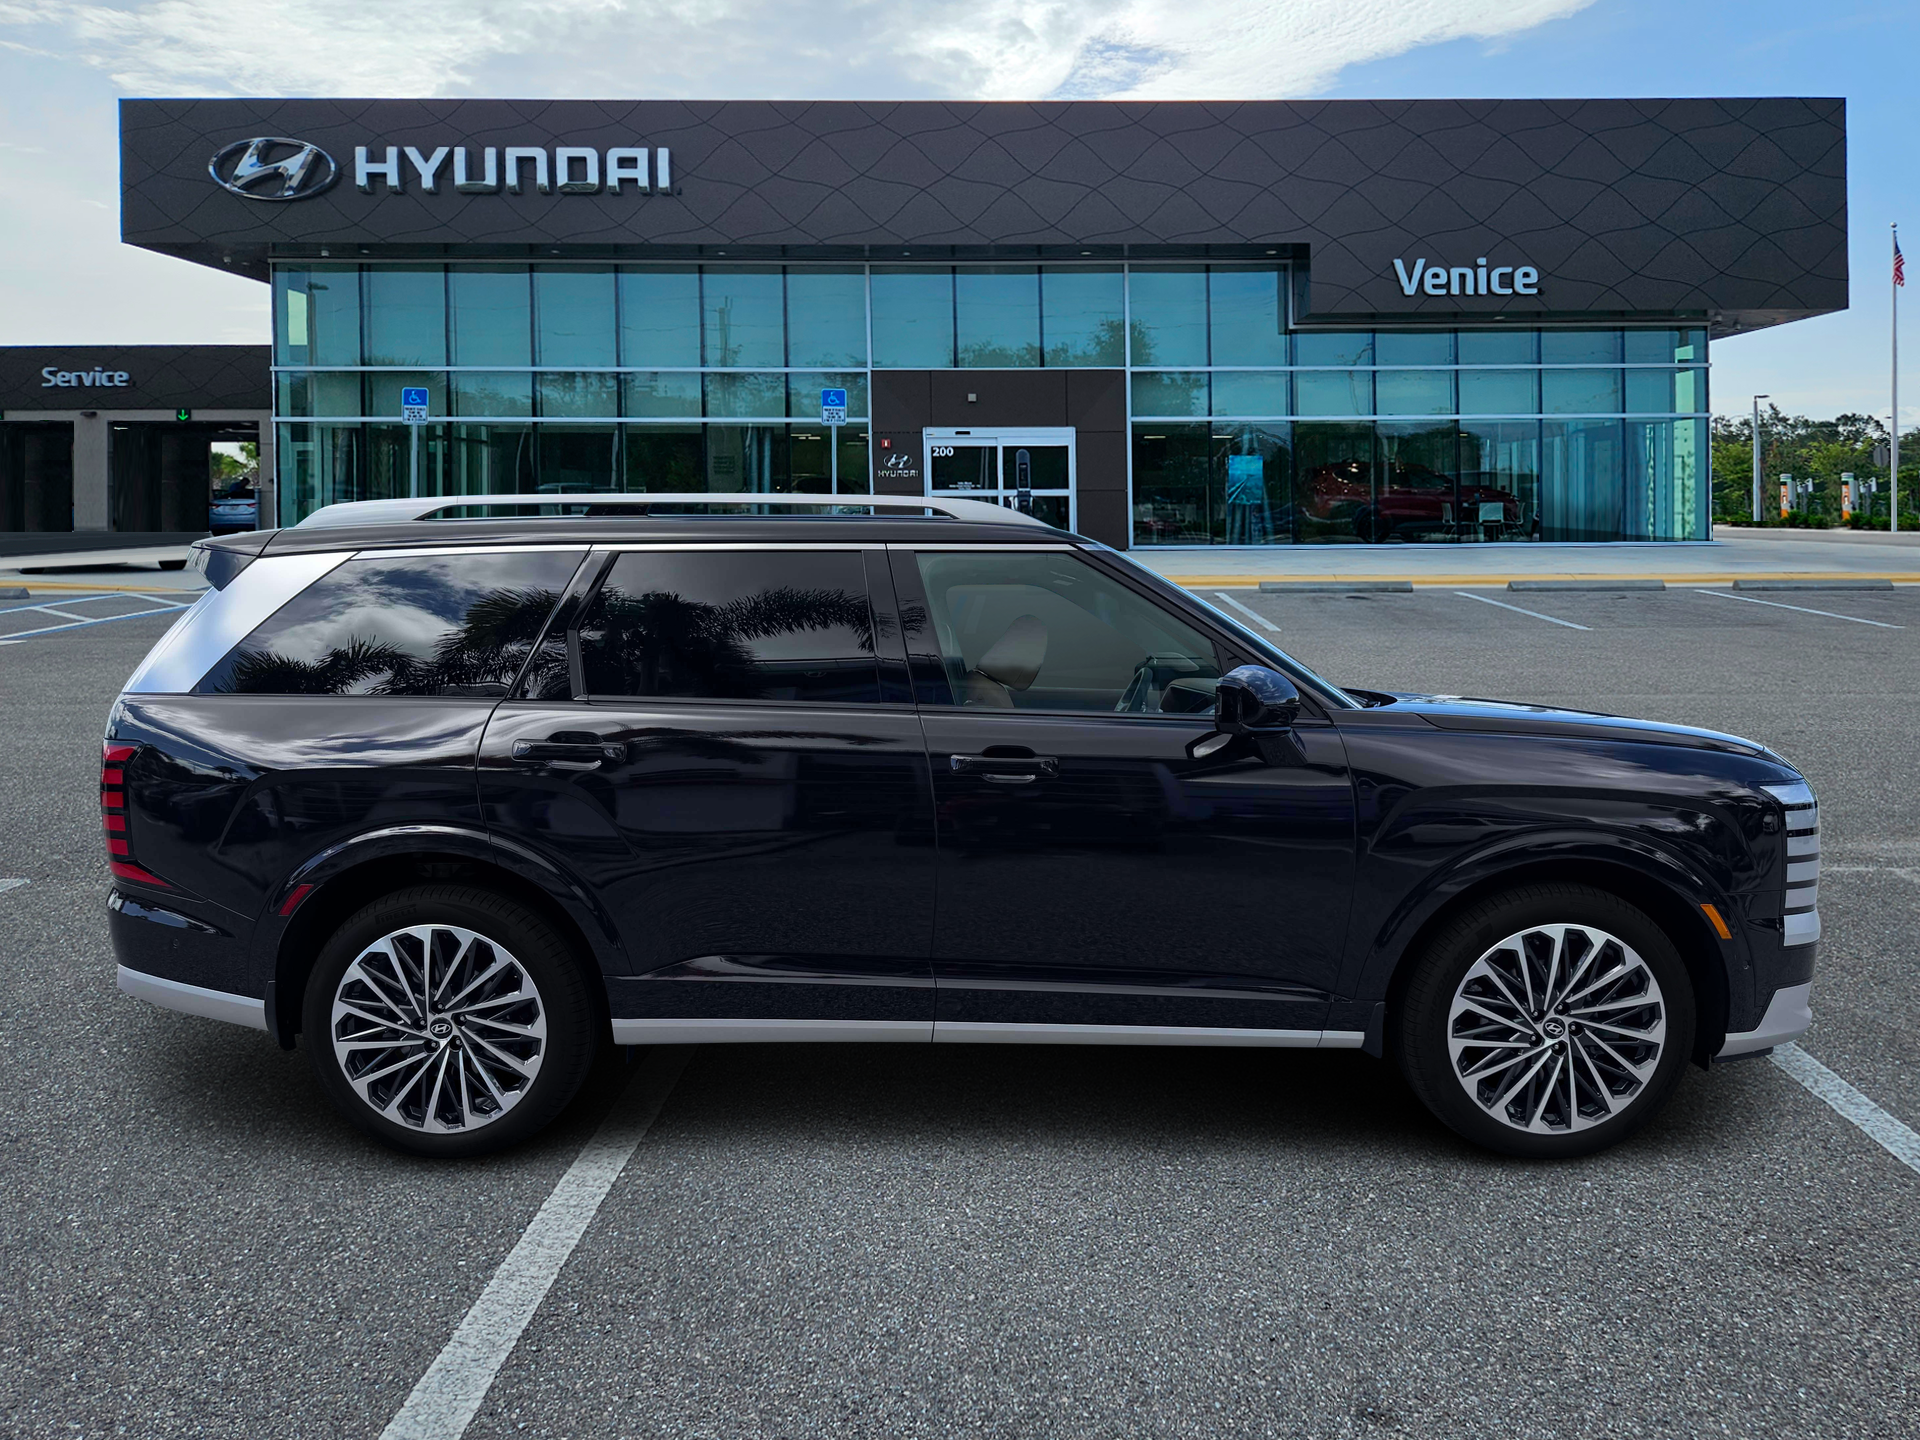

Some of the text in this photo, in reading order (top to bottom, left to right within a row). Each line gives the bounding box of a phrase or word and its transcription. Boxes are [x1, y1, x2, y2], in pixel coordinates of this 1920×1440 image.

[354, 146, 670, 193] HYUNDAI
[1392, 257, 1539, 296] Venice
[41, 366, 130, 388] Service
[932, 446, 954, 457] 200
[877, 469, 919, 478] HYUNDAI
